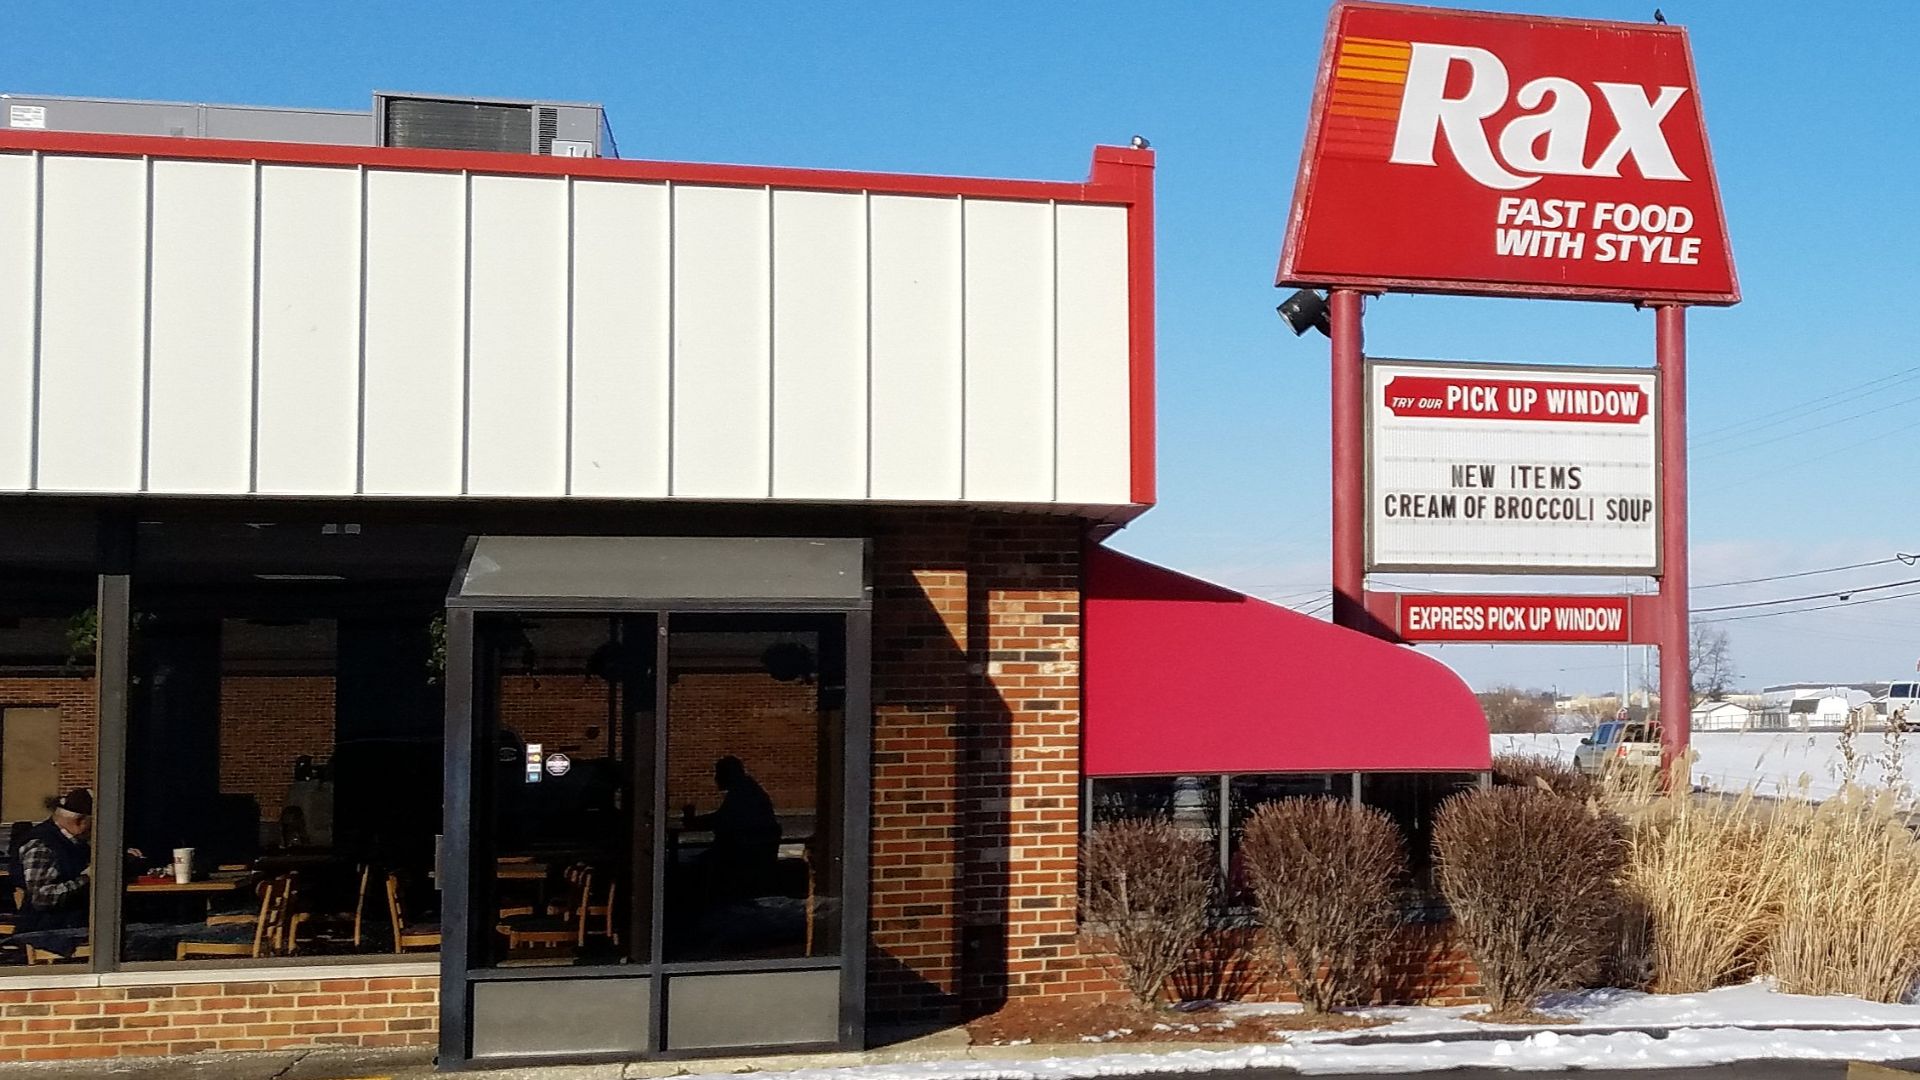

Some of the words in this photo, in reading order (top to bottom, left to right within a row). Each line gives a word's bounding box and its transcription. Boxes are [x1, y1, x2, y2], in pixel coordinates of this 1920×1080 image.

[1389, 41, 1692, 190] Rax
[1497, 197, 1585, 229] FAST
[1592, 203, 1694, 234] FOOD
[1496, 229, 1585, 260] WITH
[1594, 235, 1701, 265] STYLE
[1391, 396, 1415, 409] TRY
[1418, 398, 1444, 410] OUR
[1446, 385, 1499, 413] PICK
[1507, 387, 1538, 413] UP
[1546, 388, 1640, 416] WINDOW
[1451, 464, 1496, 489] NEW
[1510, 465, 1582, 490] ITEMS
[1385, 494, 1456, 518] CREAM
[1464, 496, 1487, 519] OF
[1494, 496, 1594, 521] BROCCOLI
[1606, 499, 1652, 522] SOUP
[1409, 606, 1485, 631] EXPRESS
[1488, 606, 1526, 631] PICK
[1529, 607, 1552, 631] UP
[1554, 608, 1622, 631] WINDOW
